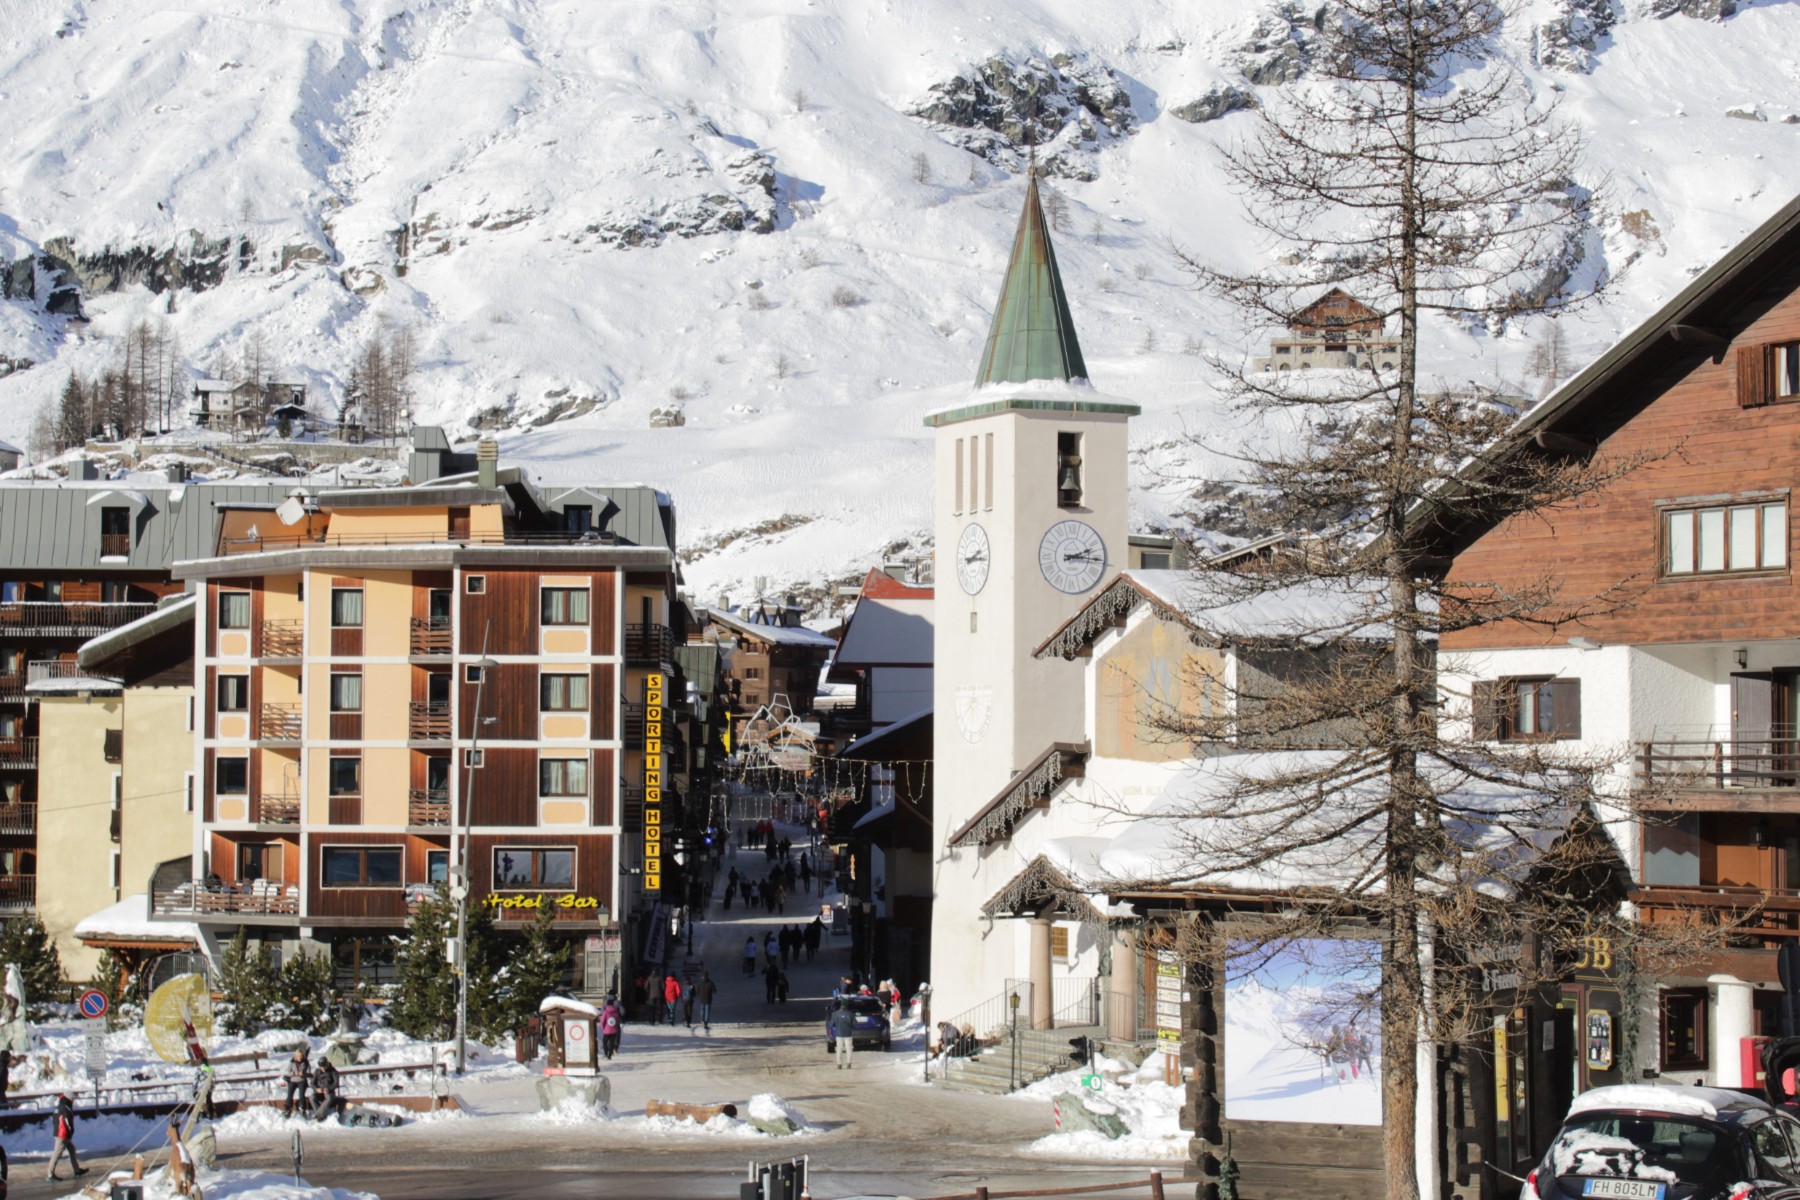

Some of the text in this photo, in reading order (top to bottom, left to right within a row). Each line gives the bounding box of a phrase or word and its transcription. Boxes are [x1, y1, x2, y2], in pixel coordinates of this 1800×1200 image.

[647, 675, 660, 801] SPORTING
[646, 811, 660, 888] HOTEL
[556, 893, 599, 908] Bar
[1593, 1181, 1656, 1197] FH 803LM
